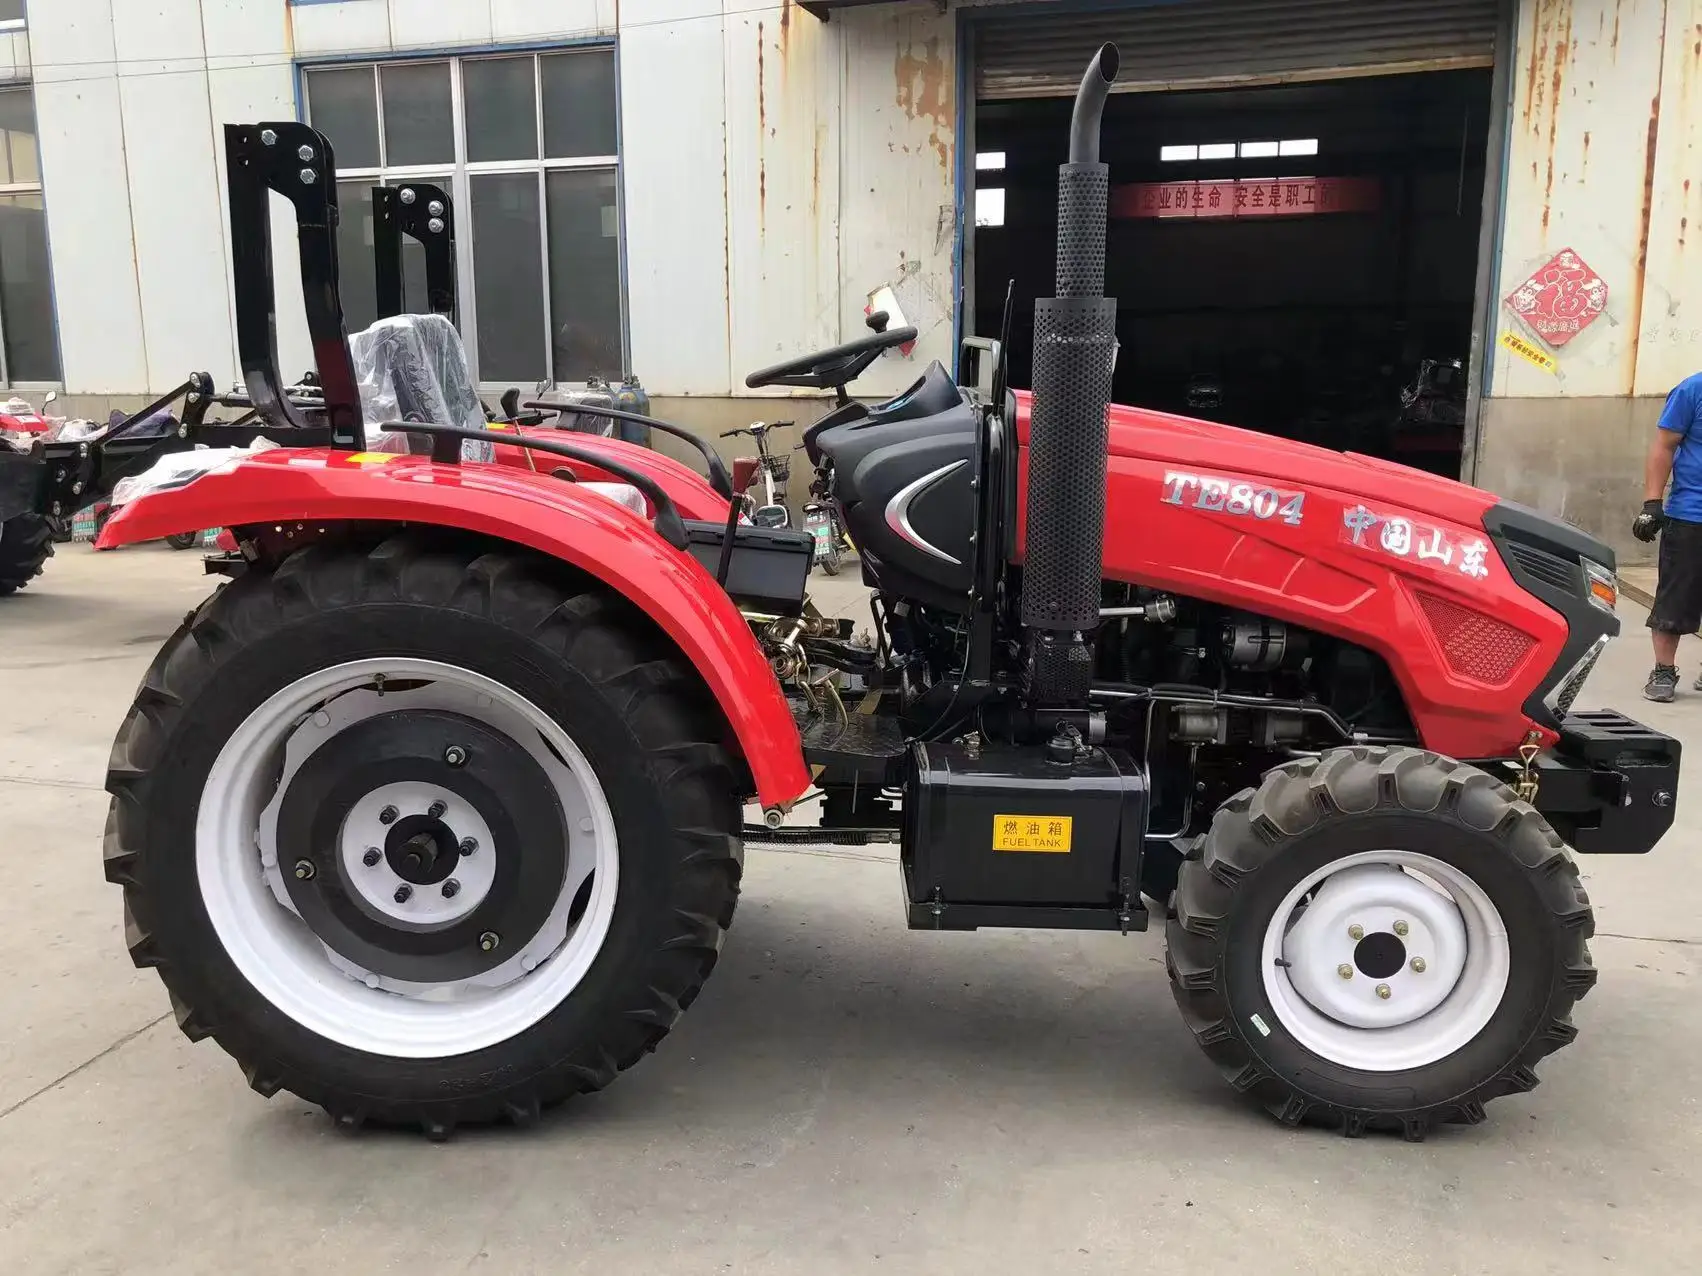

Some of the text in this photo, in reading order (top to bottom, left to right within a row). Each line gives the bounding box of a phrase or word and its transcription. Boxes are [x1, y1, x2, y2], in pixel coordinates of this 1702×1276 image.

[1161, 471, 1305, 526] TE804
[1343, 504, 1489, 580] 中国山东
[1002, 837, 1061, 847] FUEL TANK
[1003, 820, 1062, 836] 燃油箱
